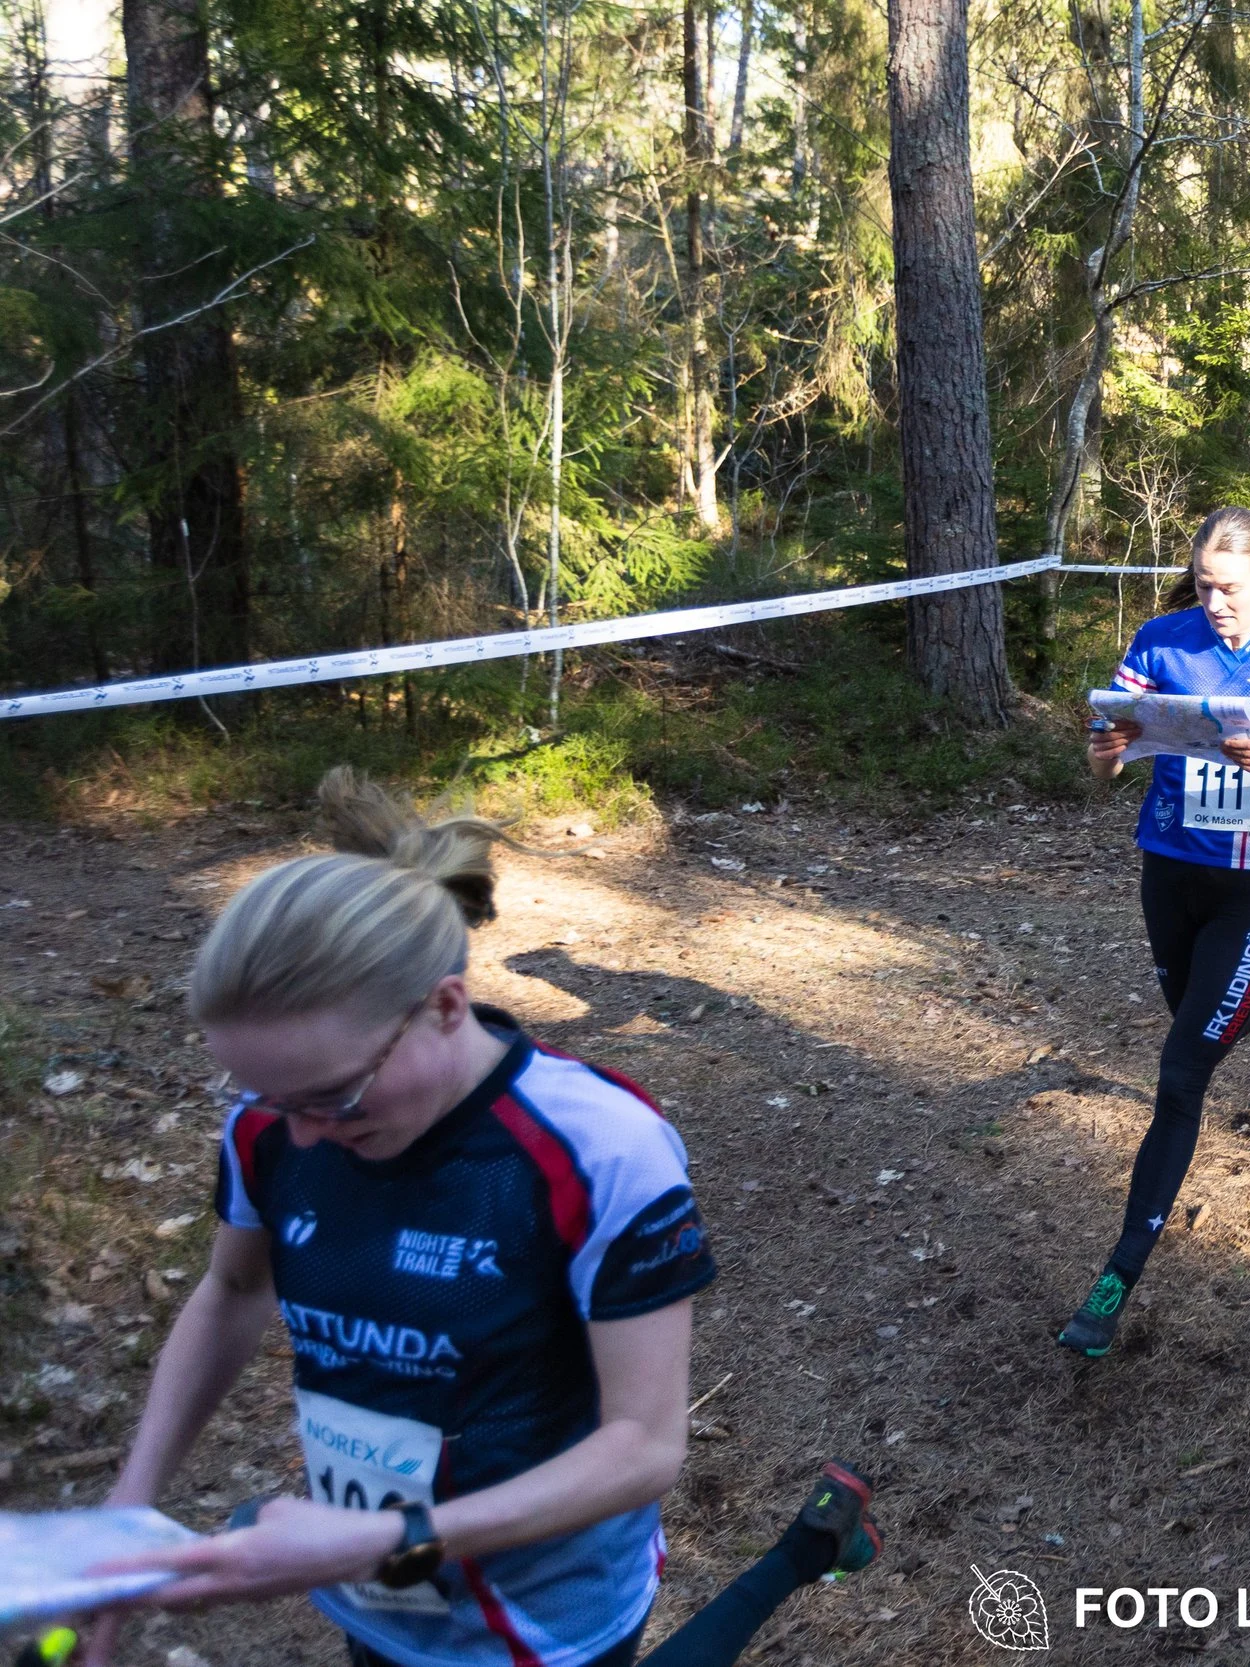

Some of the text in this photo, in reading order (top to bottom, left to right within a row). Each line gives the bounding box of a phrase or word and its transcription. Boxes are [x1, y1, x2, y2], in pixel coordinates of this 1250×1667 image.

[1196, 762, 1244, 810] 111
[1194, 813, 1244, 825] OK Måsen
[1202, 1009, 1234, 1040] IFK
[398, 1228, 451, 1254] NIGHT
[394, 1250, 442, 1276] TRAIL
[304, 1417, 381, 1467] NOREX
